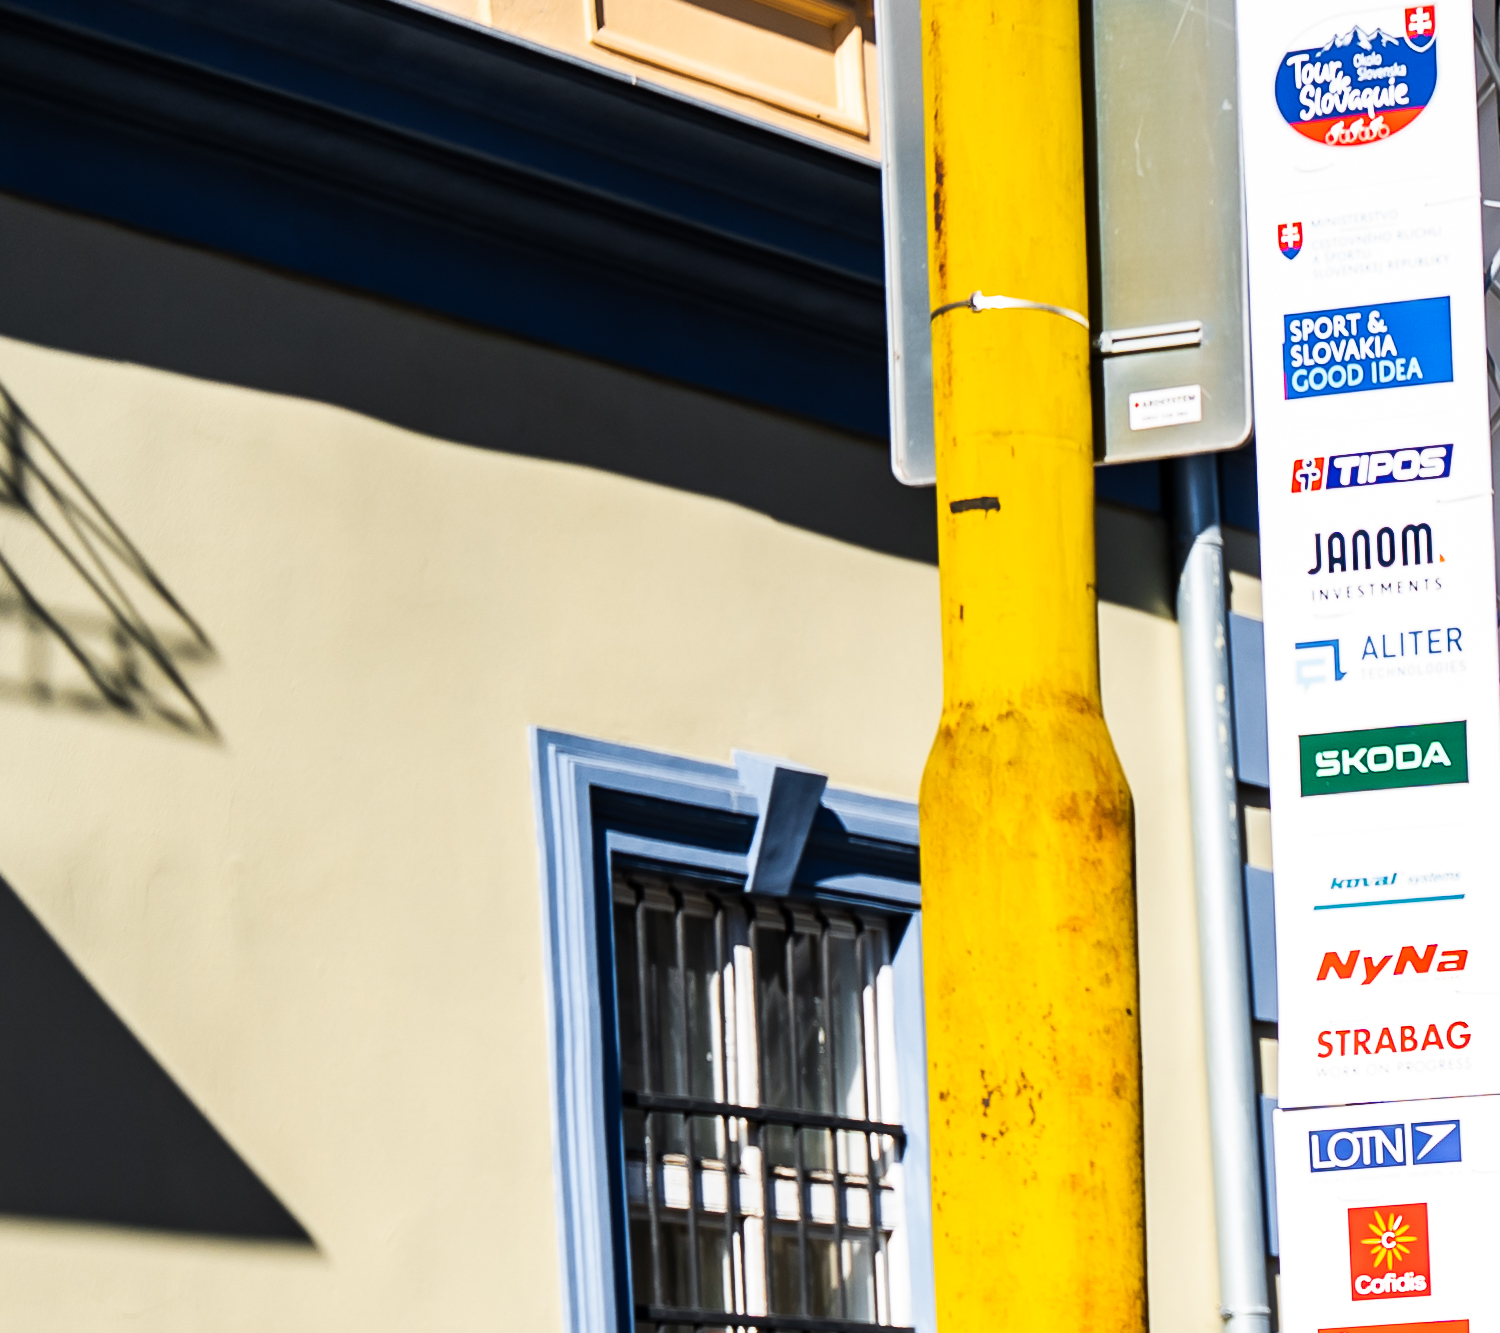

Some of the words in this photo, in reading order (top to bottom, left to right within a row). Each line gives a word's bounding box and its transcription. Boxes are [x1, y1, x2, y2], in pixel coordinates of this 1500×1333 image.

[1287, 52, 1343, 90] Tour
[1299, 80, 1410, 122] Slovaquie
[1288, 313, 1362, 342] SPORT
[1368, 310, 1388, 335] &
[1289, 337, 1399, 369] SLOVAKIA
[1292, 361, 1365, 394] GOOD
[1371, 356, 1424, 385] IDEA
[1333, 447, 1447, 486] TIPOS
[1310, 577, 1443, 602] INVESTMENTS
[1361, 627, 1464, 662] ALITER
[1316, 943, 1468, 986] NyNa
[1316, 1020, 1472, 1059] STRABAG
[1310, 1127, 1404, 1170] LOTN
[1354, 1272, 1428, 1297] Cofidis
